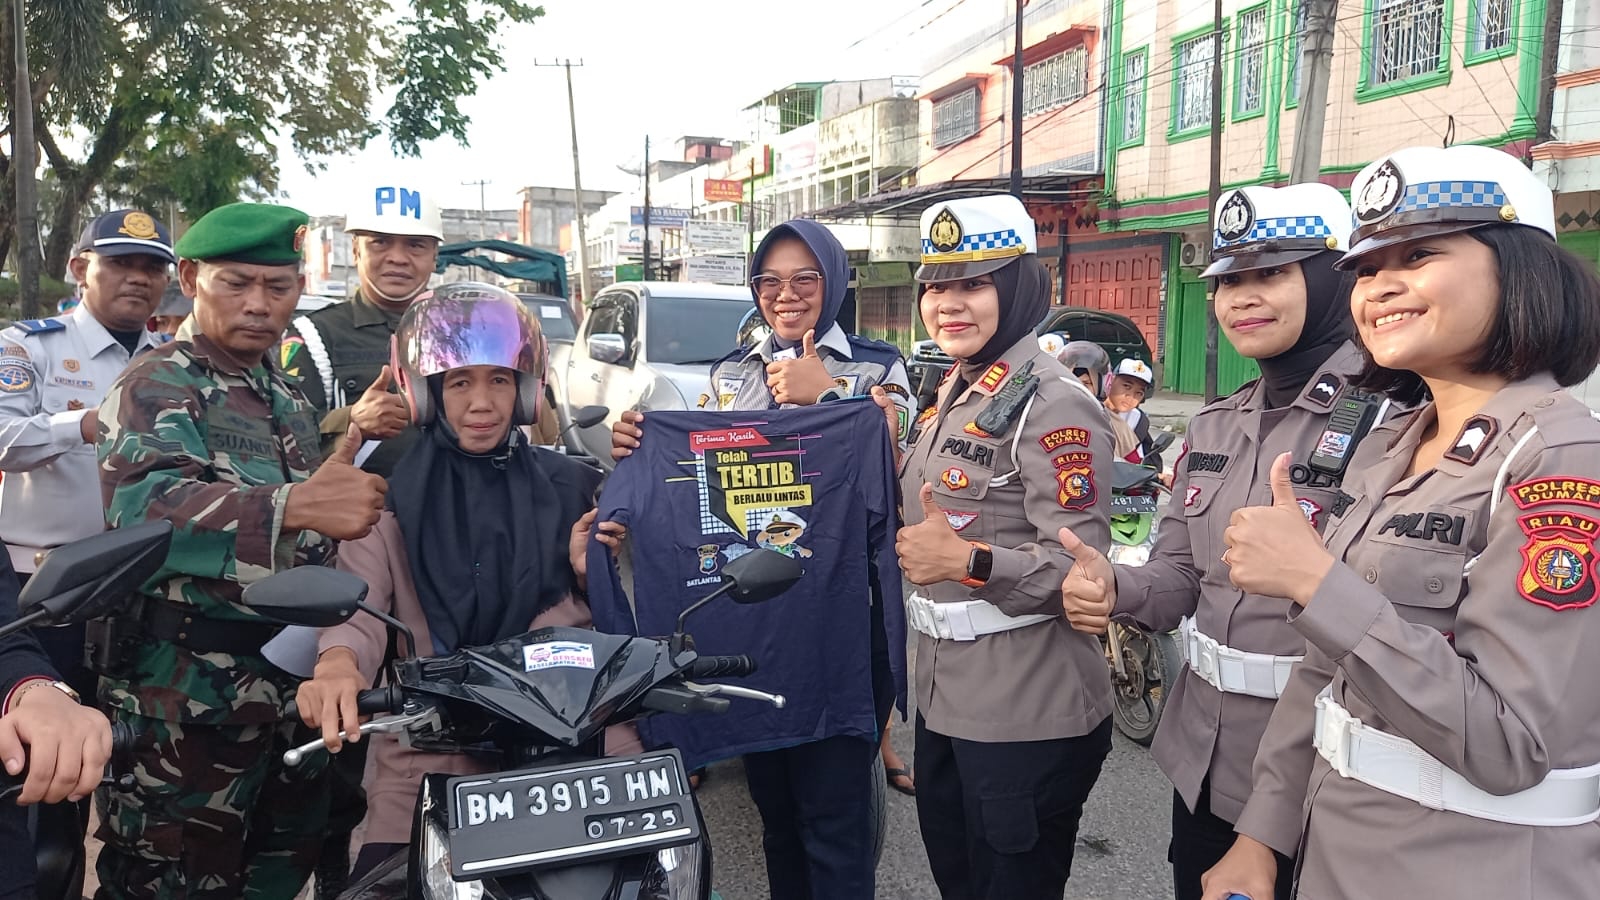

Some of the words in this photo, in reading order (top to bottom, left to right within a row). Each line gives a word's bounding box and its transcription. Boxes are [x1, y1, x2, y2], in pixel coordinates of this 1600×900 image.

[375, 187, 421, 219] PM
[692, 434, 725, 445] Terima
[728, 431, 756, 442] Kasih
[1044, 428, 1087, 443] POLRES
[1048, 435, 1087, 448] DUMAI
[716, 451, 748, 464] Telah
[940, 438, 994, 467] POLRI
[1057, 453, 1089, 464] RIAU
[716, 461, 795, 489] TERTIB
[1518, 481, 1600, 497] POLRES
[1528, 490, 1592, 503] DUMAI
[733, 492, 773, 505] BERLALU
[774, 490, 806, 502] LINTAS
[1378, 512, 1466, 546] POLRI
[1529, 516, 1594, 531] RIAU
[686, 576, 722, 587] SATLANTAS
[466, 790, 515, 826] BM
[527, 775, 612, 816] 3915
[624, 767, 671, 801] HN
